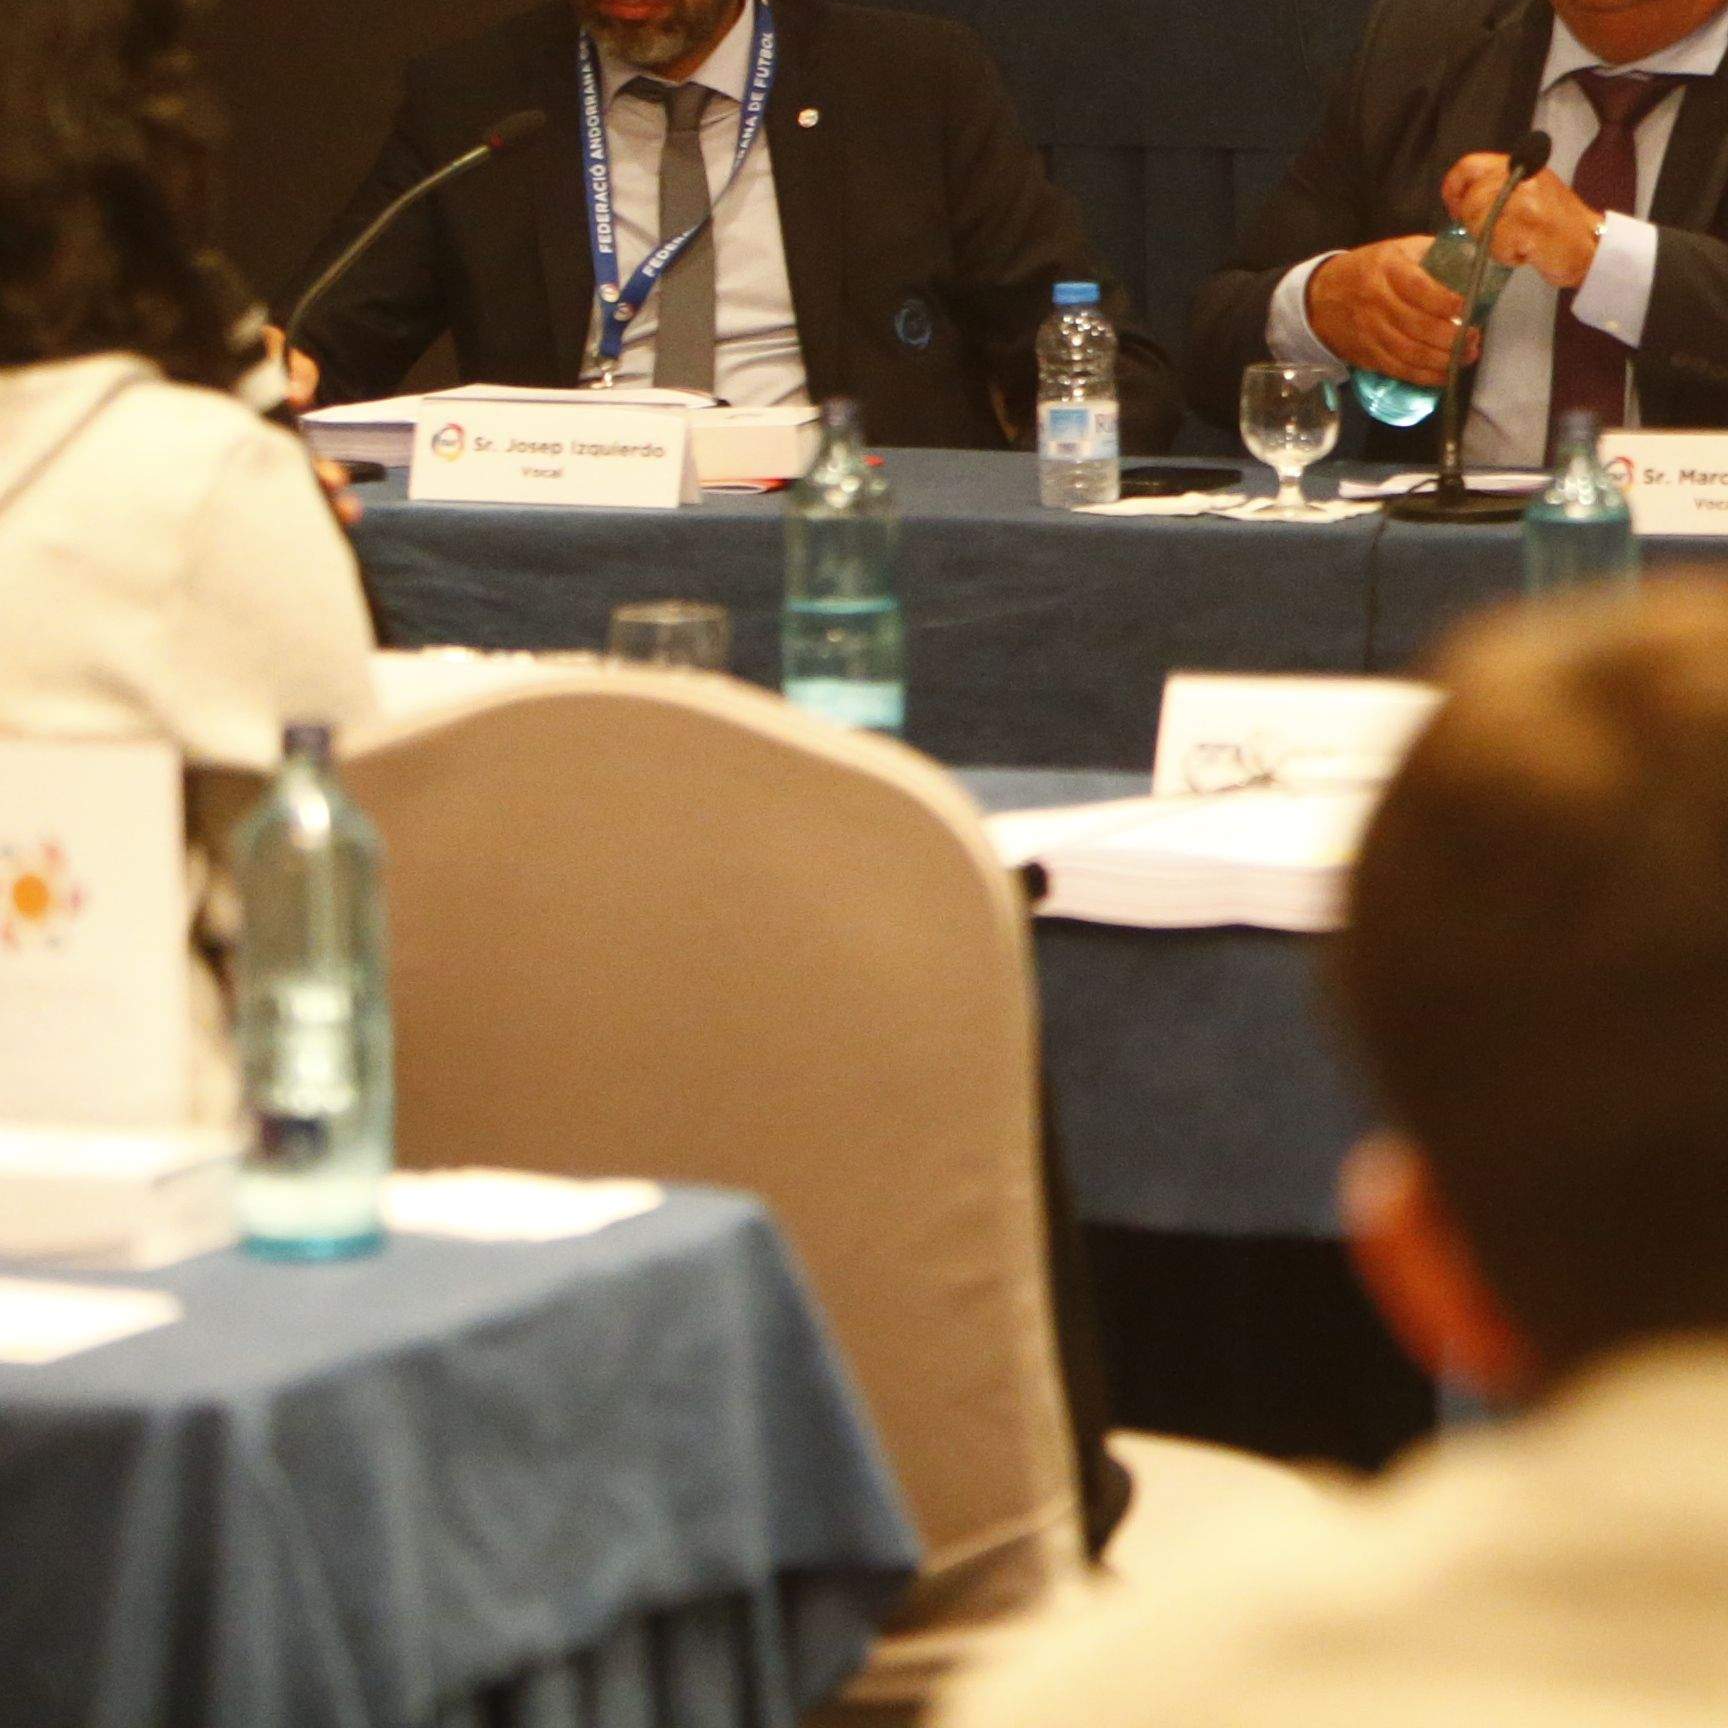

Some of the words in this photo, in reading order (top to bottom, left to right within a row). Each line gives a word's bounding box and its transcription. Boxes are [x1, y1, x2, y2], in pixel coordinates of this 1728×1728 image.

[752, 31, 776, 85] FUTBOL
[593, 161, 616, 254] FEDERACIÓ
[1642, 468, 1671, 486] Sr.
